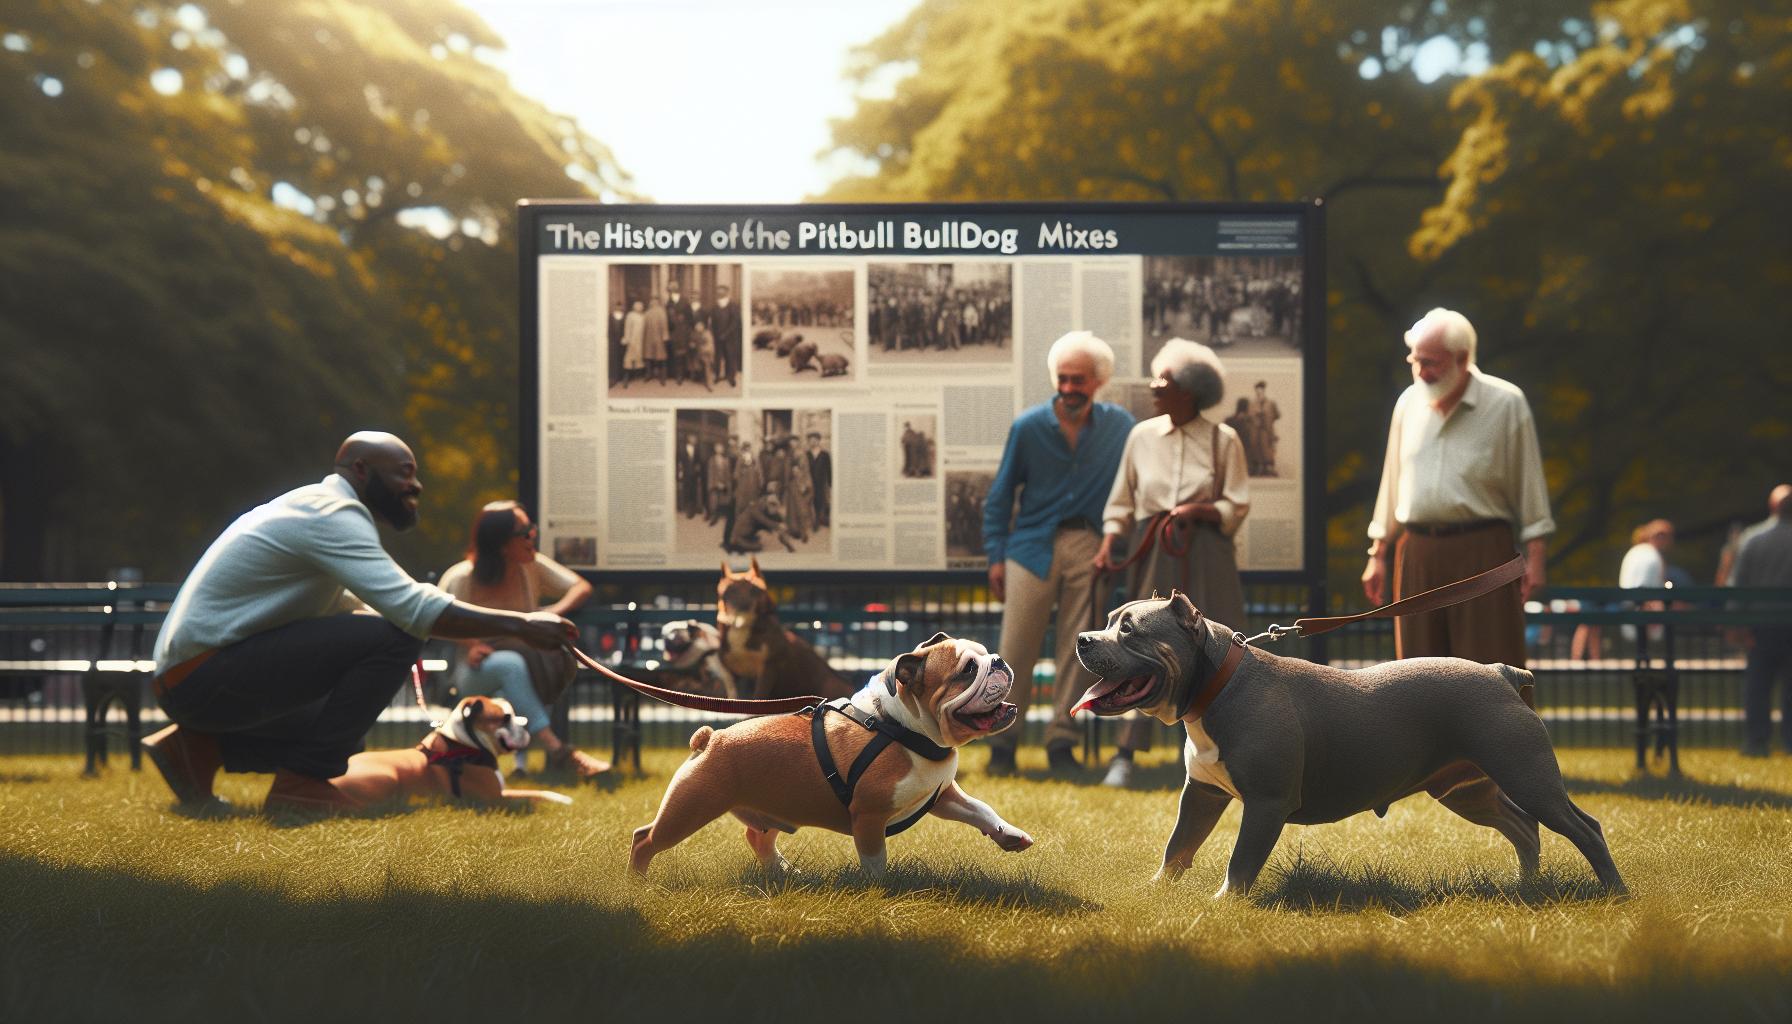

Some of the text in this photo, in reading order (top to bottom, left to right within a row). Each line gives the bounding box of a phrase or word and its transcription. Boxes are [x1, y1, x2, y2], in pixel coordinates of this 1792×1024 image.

[545, 222, 600, 249] The
[604, 222, 702, 254] History
[798, 221, 894, 249] Pitbull
[903, 221, 1018, 254] BullDog
[1038, 221, 1119, 249] Mixes
